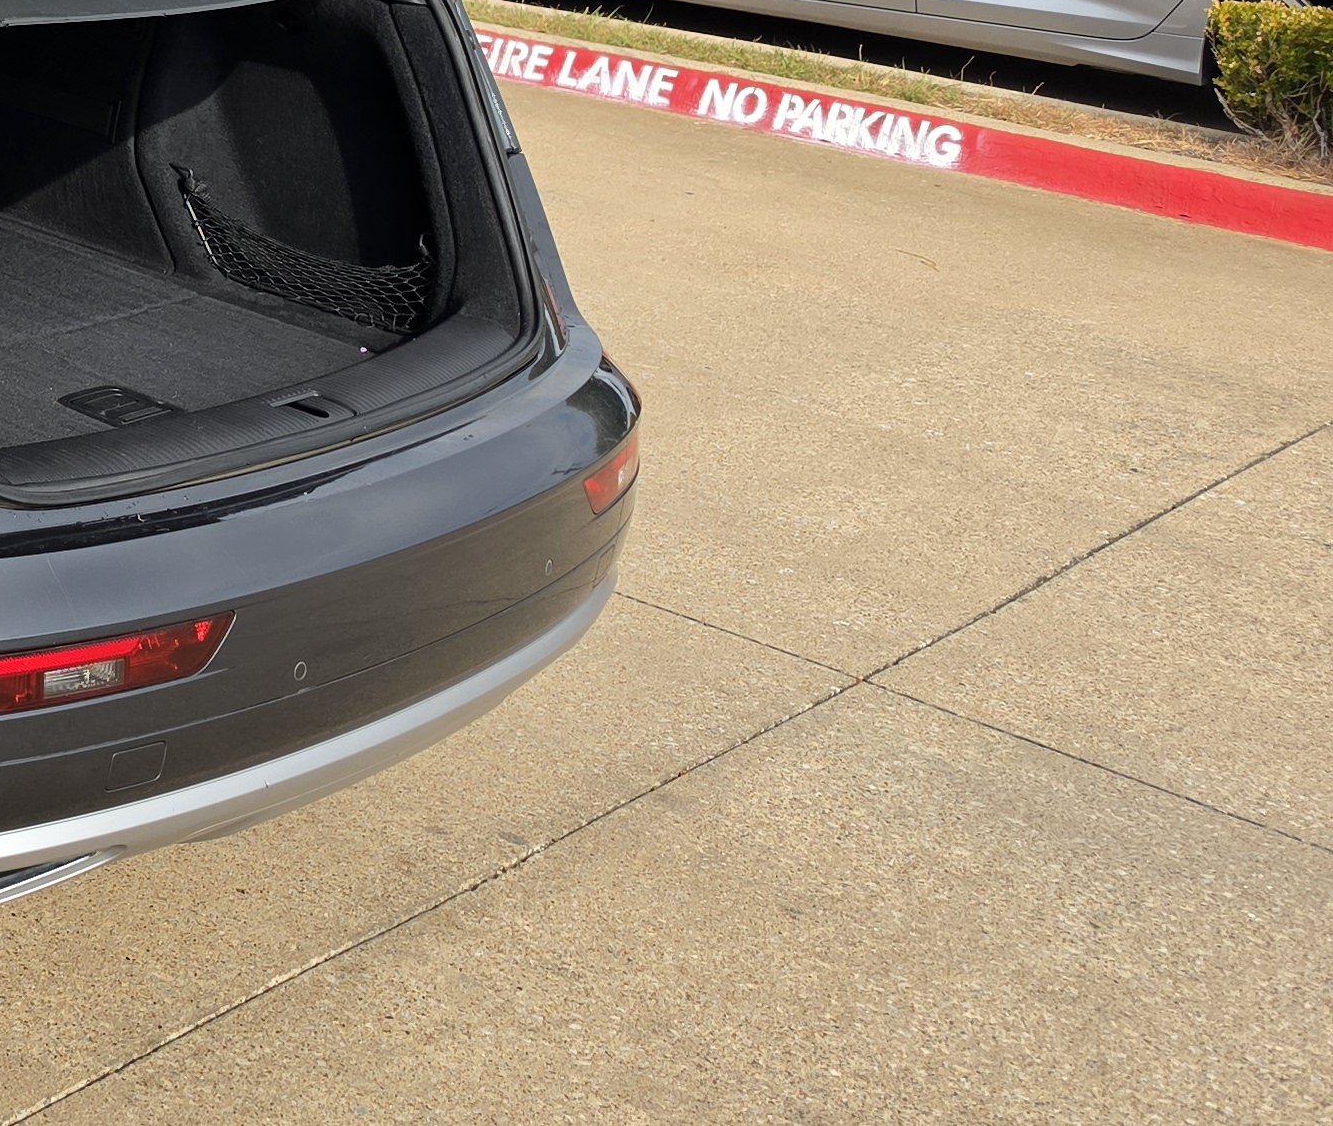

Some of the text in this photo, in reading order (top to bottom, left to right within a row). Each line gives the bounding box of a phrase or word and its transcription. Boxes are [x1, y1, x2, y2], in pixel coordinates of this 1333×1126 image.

[556, 50, 679, 106] LANE
[697, 78, 768, 124] NO
[772, 91, 964, 167] PARKING
